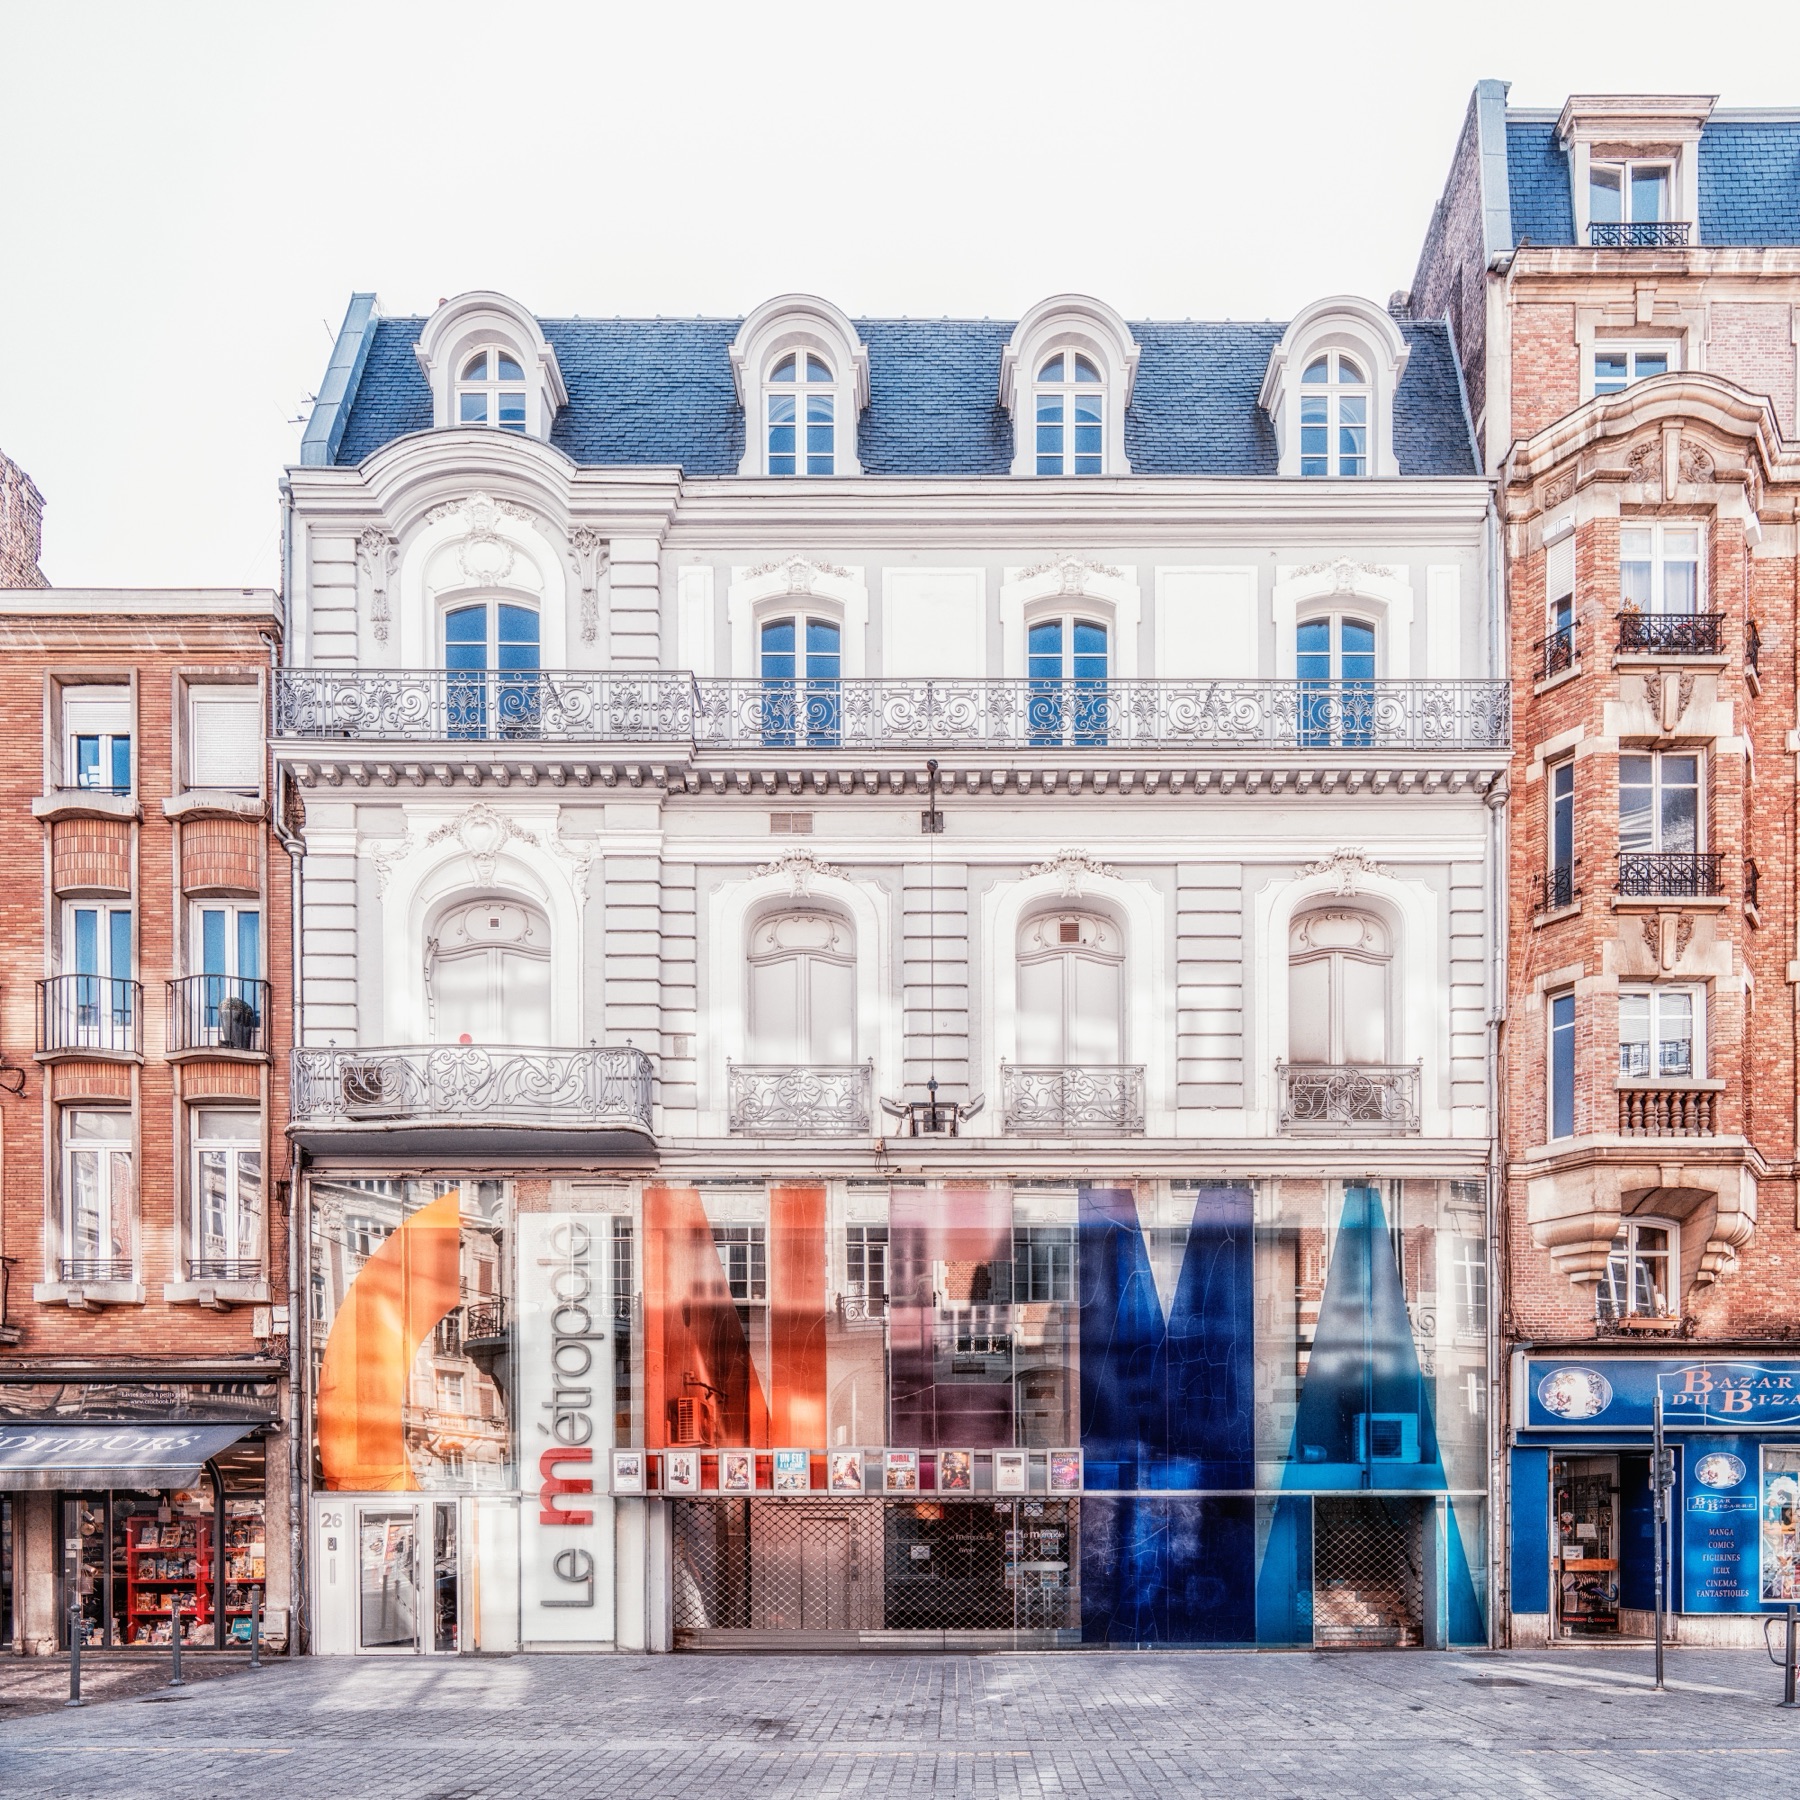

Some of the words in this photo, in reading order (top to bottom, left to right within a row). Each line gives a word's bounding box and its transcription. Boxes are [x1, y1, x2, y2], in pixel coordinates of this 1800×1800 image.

[537, 1220, 605, 1526] métropole
[0, 1433, 202, 1453] DITEURS
[321, 1512, 343, 1528] 26
[1709, 1528, 1734, 1536] MANGA
[1708, 1541, 1735, 1549] COMICS
[1702, 1554, 1741, 1562] FIGURINES
[1713, 1566, 1731, 1575] JEUX
[540, 1547, 594, 1608] Le
[1706, 1579, 1738, 1587] CINEMAS
[1697, 1589, 1750, 1598] FANTASTIQUES
